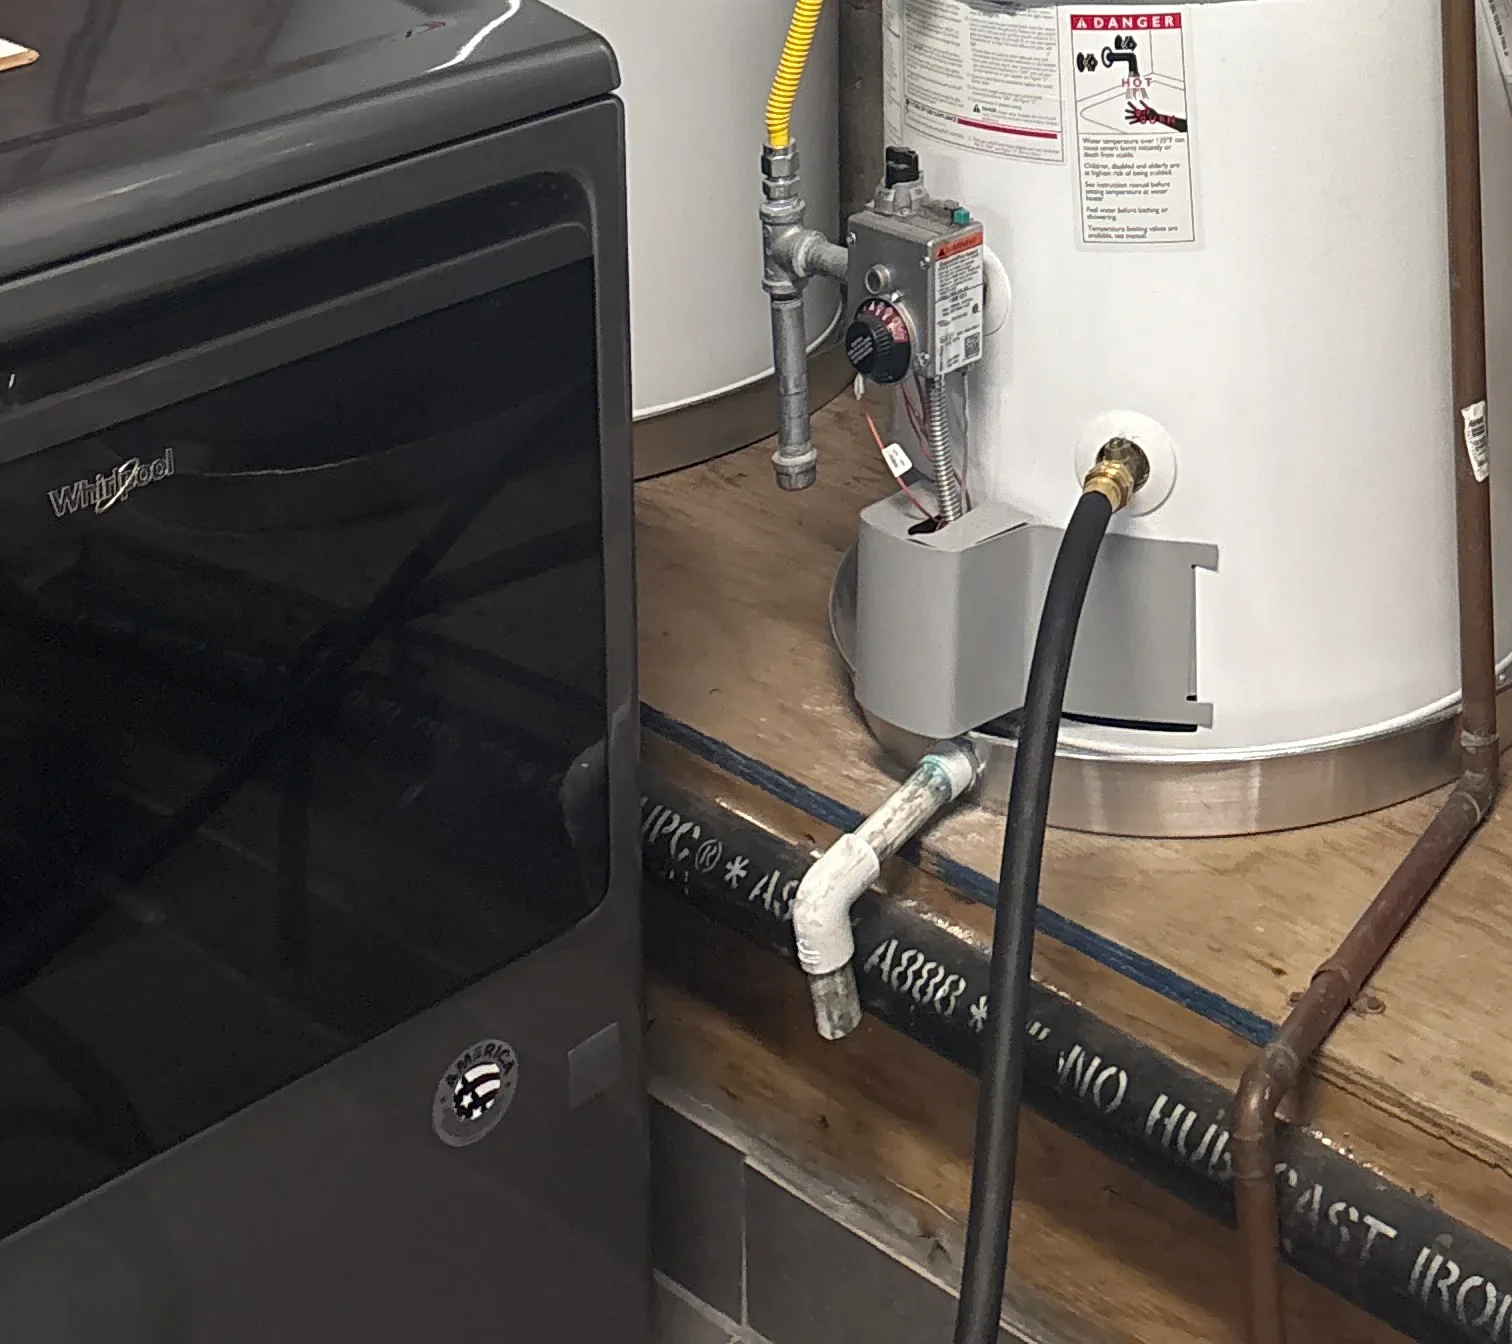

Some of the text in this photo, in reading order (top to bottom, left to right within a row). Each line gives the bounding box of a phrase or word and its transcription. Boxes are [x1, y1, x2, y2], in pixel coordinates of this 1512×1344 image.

[1093, 15, 1174, 28] DANGER
[1121, 77, 1152, 88] HOT
[46, 448, 175, 518] Whirlpool
[864, 939, 967, 1016] A888
[446, 1042, 515, 1088] AMERICA
[1057, 1044, 1128, 1114] NO
